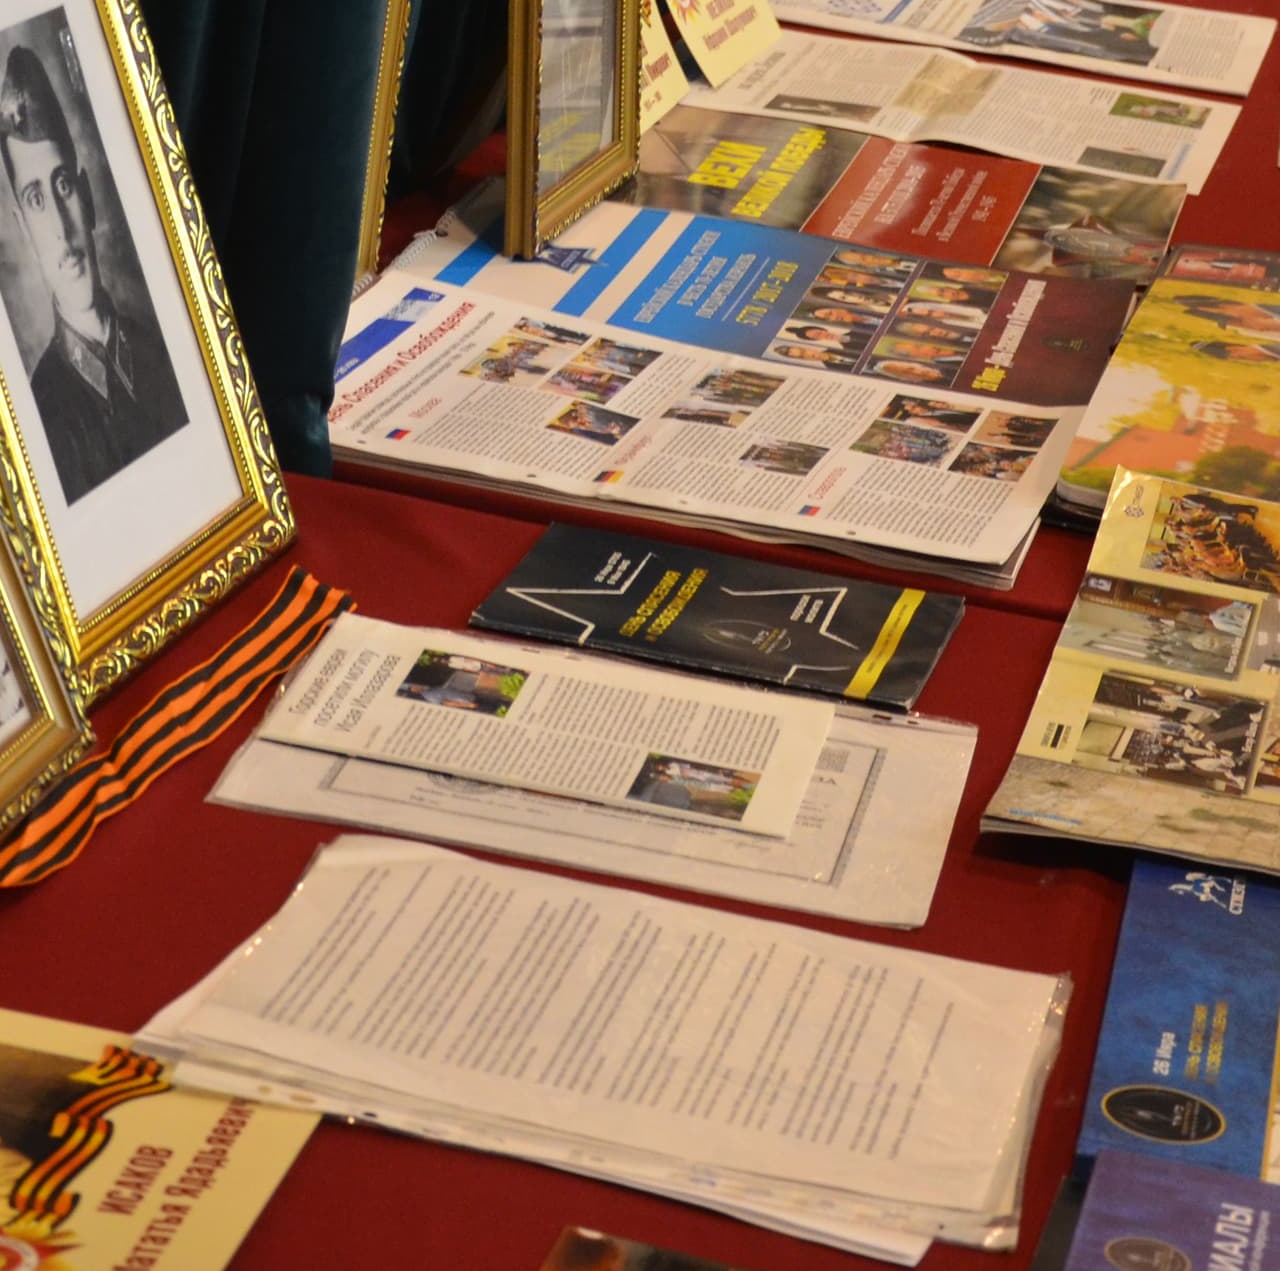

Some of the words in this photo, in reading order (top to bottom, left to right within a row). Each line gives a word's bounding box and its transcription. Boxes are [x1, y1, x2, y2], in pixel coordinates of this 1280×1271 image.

[342, 364, 401, 403] Спасения
[397, 301, 476, 361] Освобождения
[636, 569, 682, 616] СПАСЕНИЯ
[648, 568, 709, 635] ОСВОБОЖДЕНИЯ
[97, 1143, 174, 1216] ИСАКОВ
